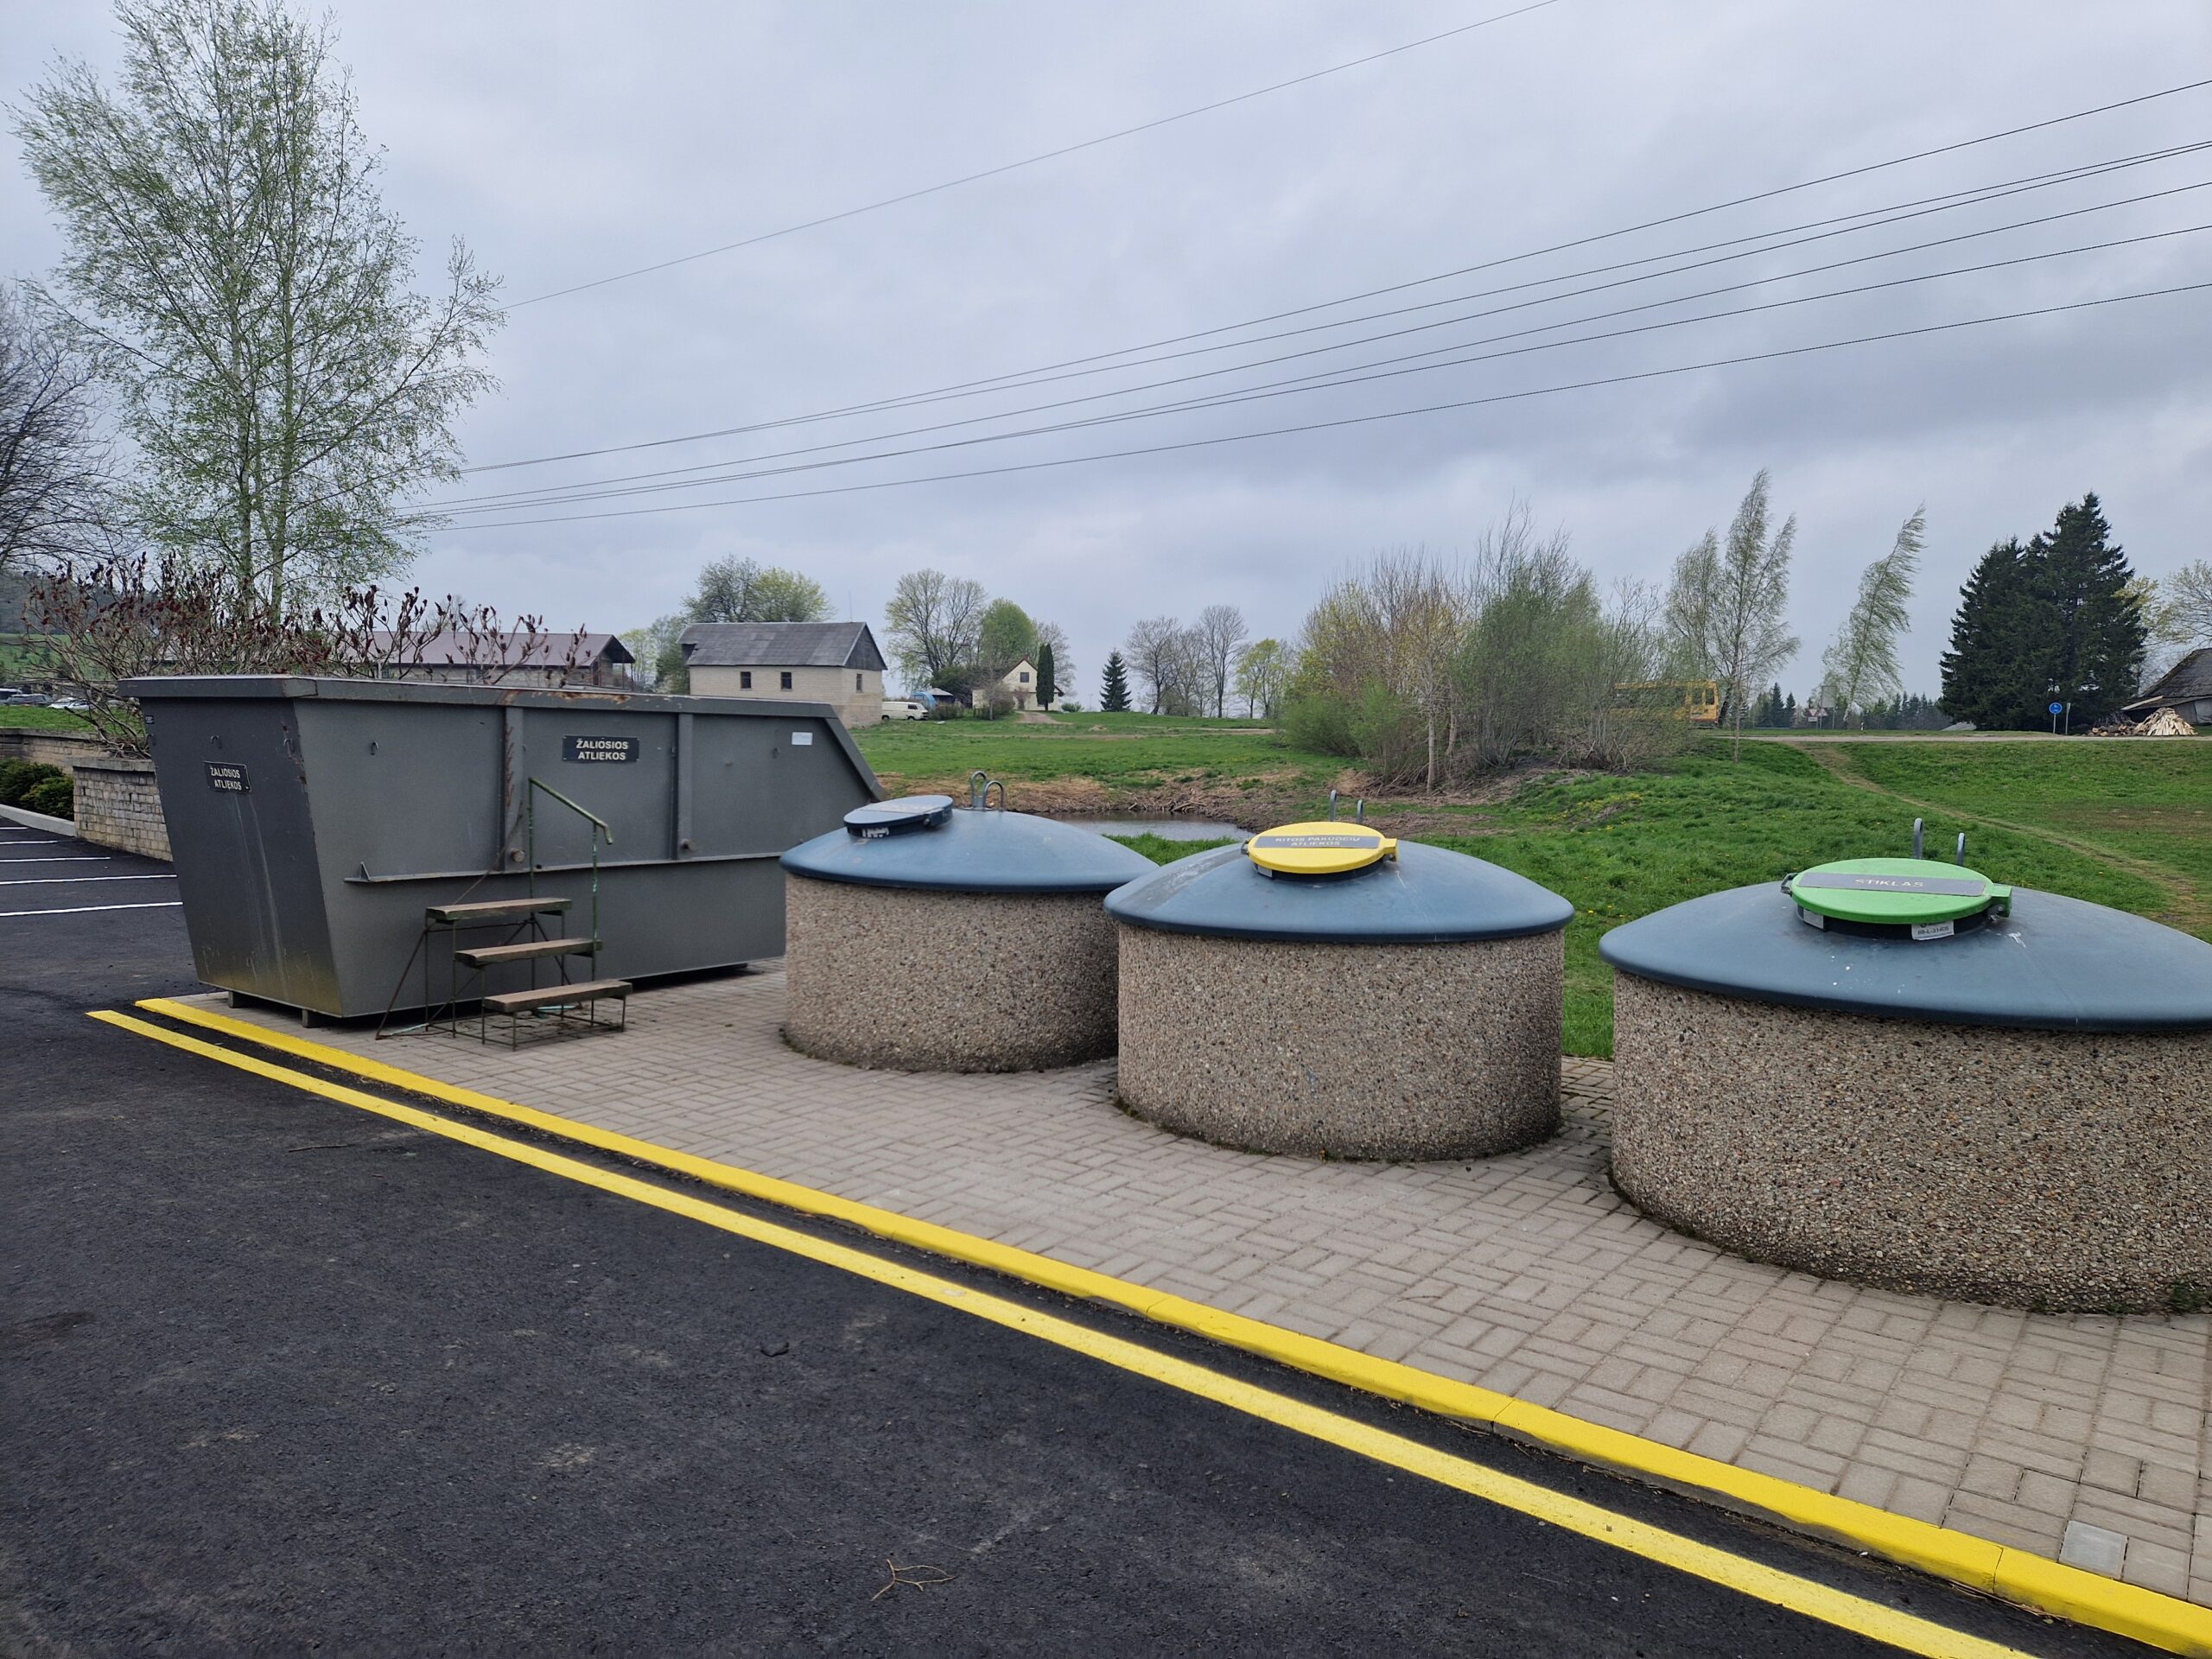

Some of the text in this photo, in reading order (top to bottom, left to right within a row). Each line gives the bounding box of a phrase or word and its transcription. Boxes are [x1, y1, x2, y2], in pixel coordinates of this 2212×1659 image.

[575, 738, 629, 750] ŽALIOSIOS
[577, 751, 626, 760] ATLIEKOS
[214, 779, 242, 791] ATLIEKOS
